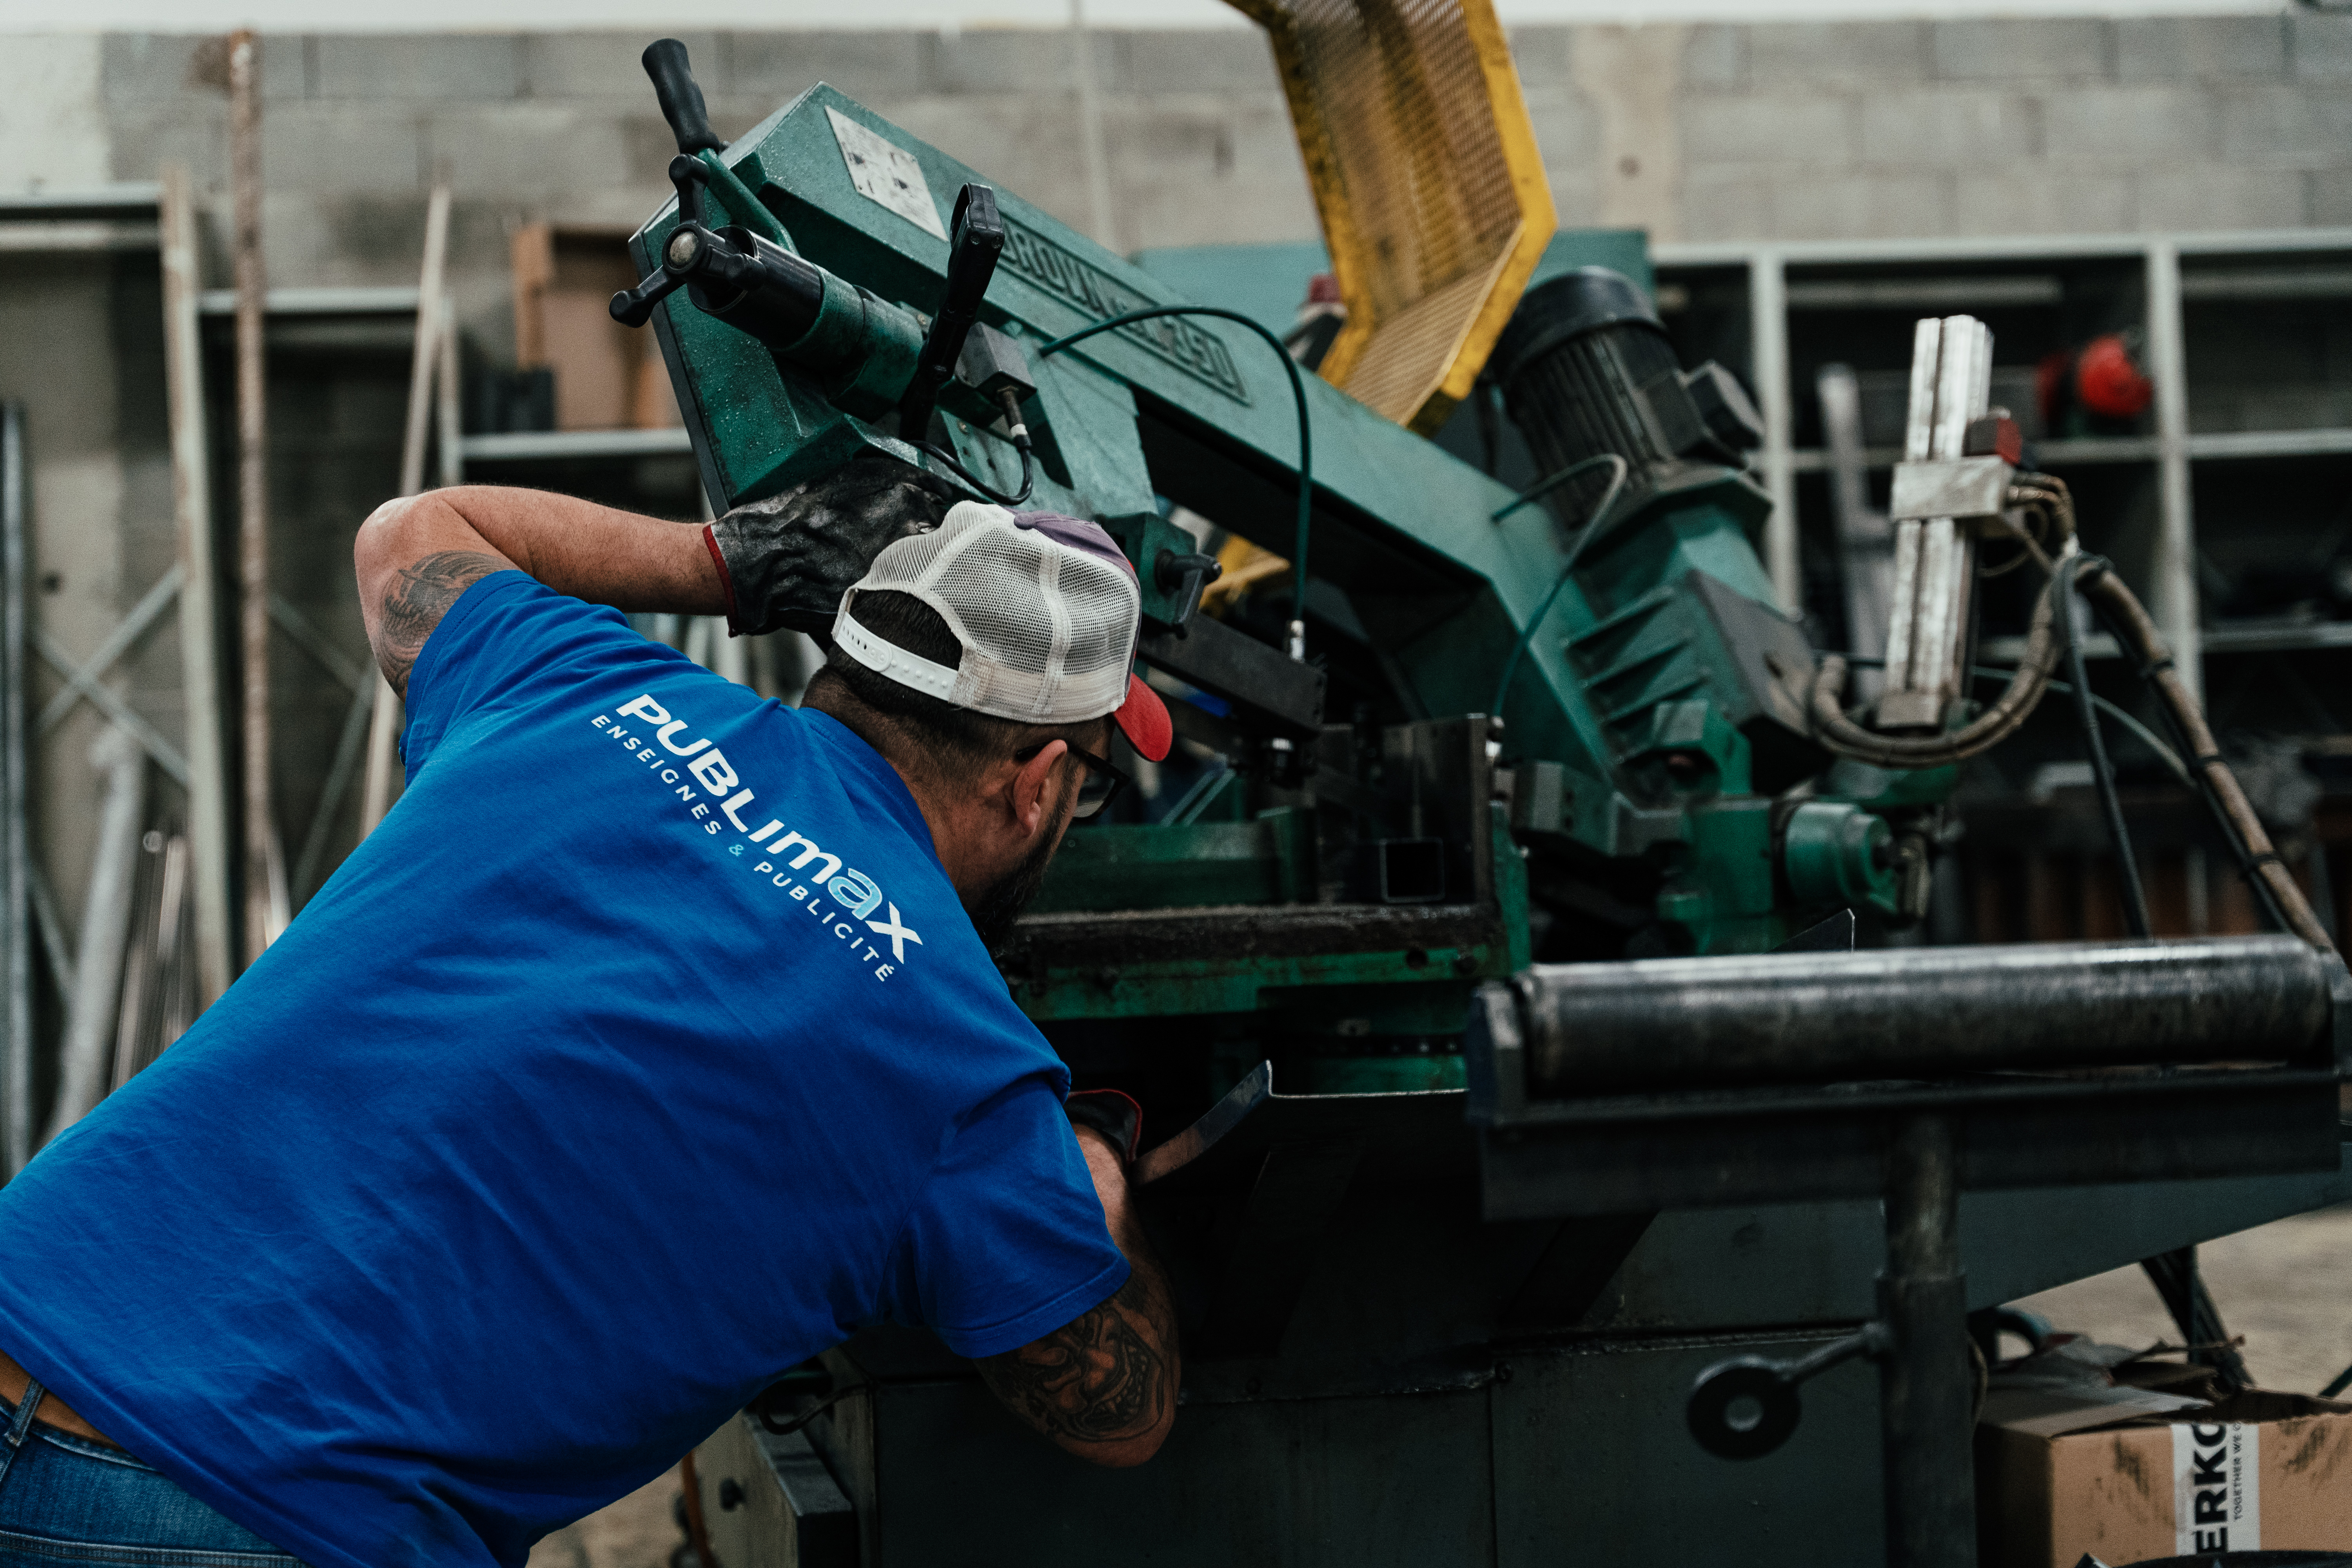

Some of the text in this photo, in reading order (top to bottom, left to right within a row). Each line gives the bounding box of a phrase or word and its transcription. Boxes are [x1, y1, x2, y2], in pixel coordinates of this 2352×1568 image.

[591, 715, 895, 982] ENSEIGNES & PUBLICITÉ
